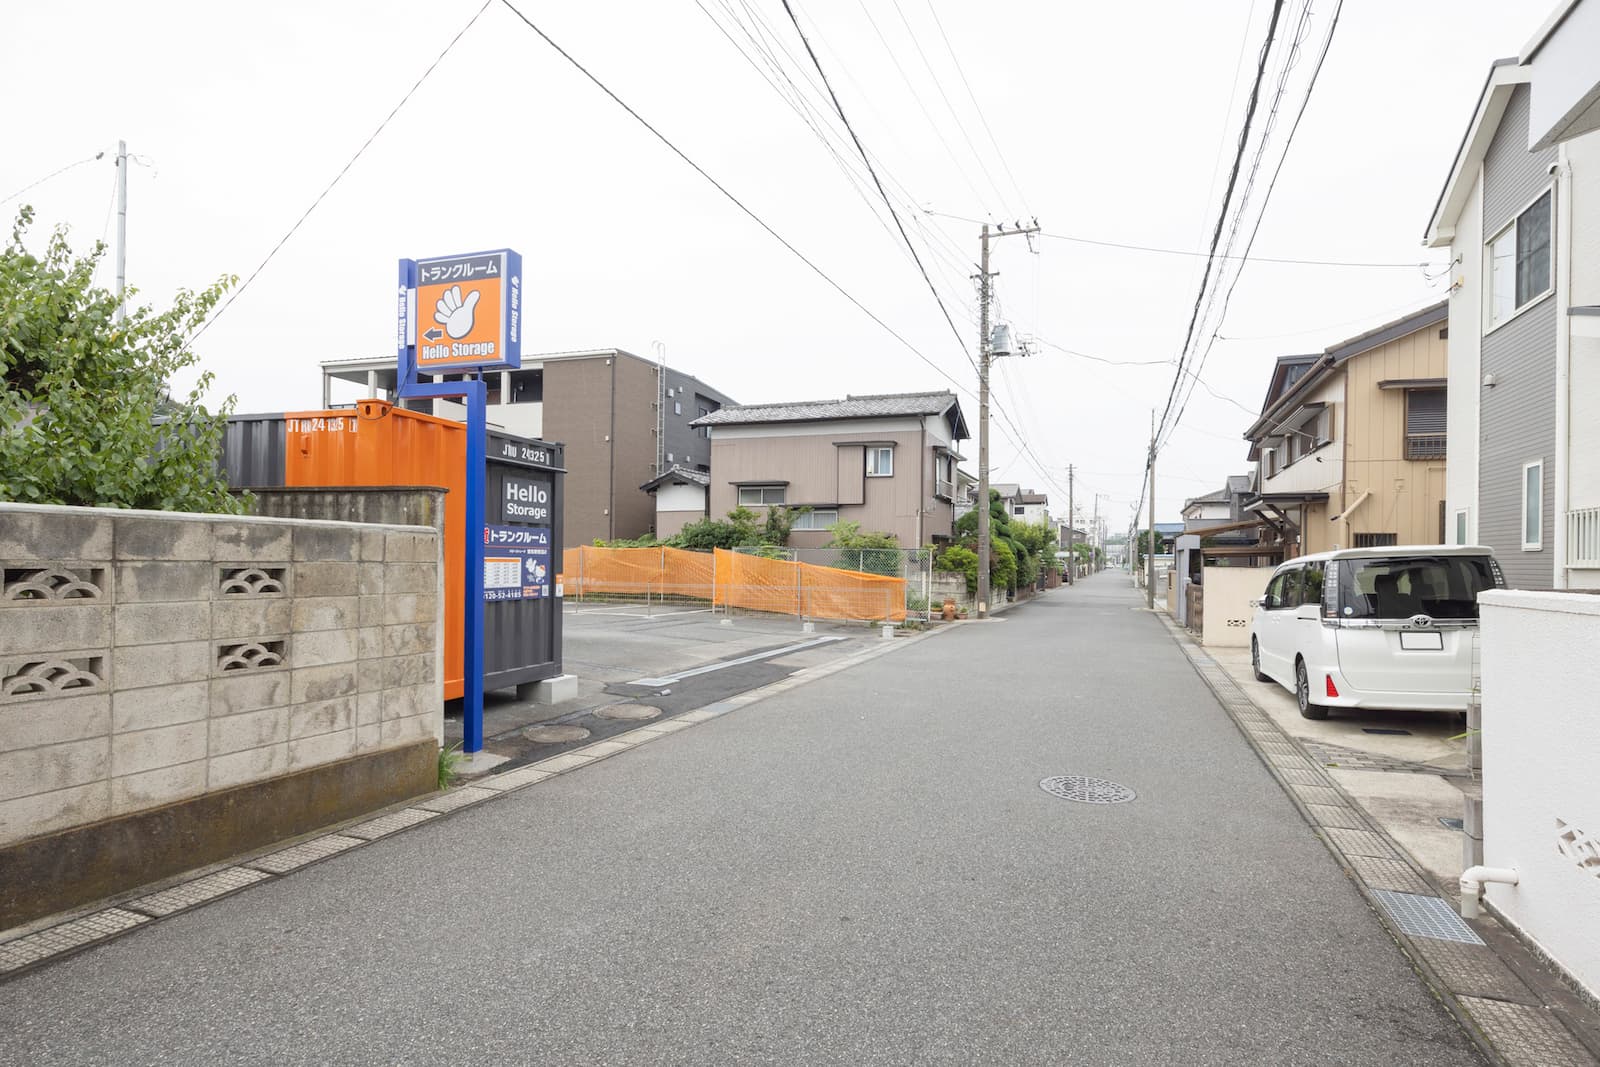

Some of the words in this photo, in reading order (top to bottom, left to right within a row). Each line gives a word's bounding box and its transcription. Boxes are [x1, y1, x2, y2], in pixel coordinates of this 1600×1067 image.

[421, 260, 498, 282] トランクルーム
[422, 344, 450, 360] Hello
[452, 341, 495, 357] Storage
[507, 483, 547, 503] Hello
[507, 503, 547, 519] Storage
[491, 530, 547, 544] トランクルーム
